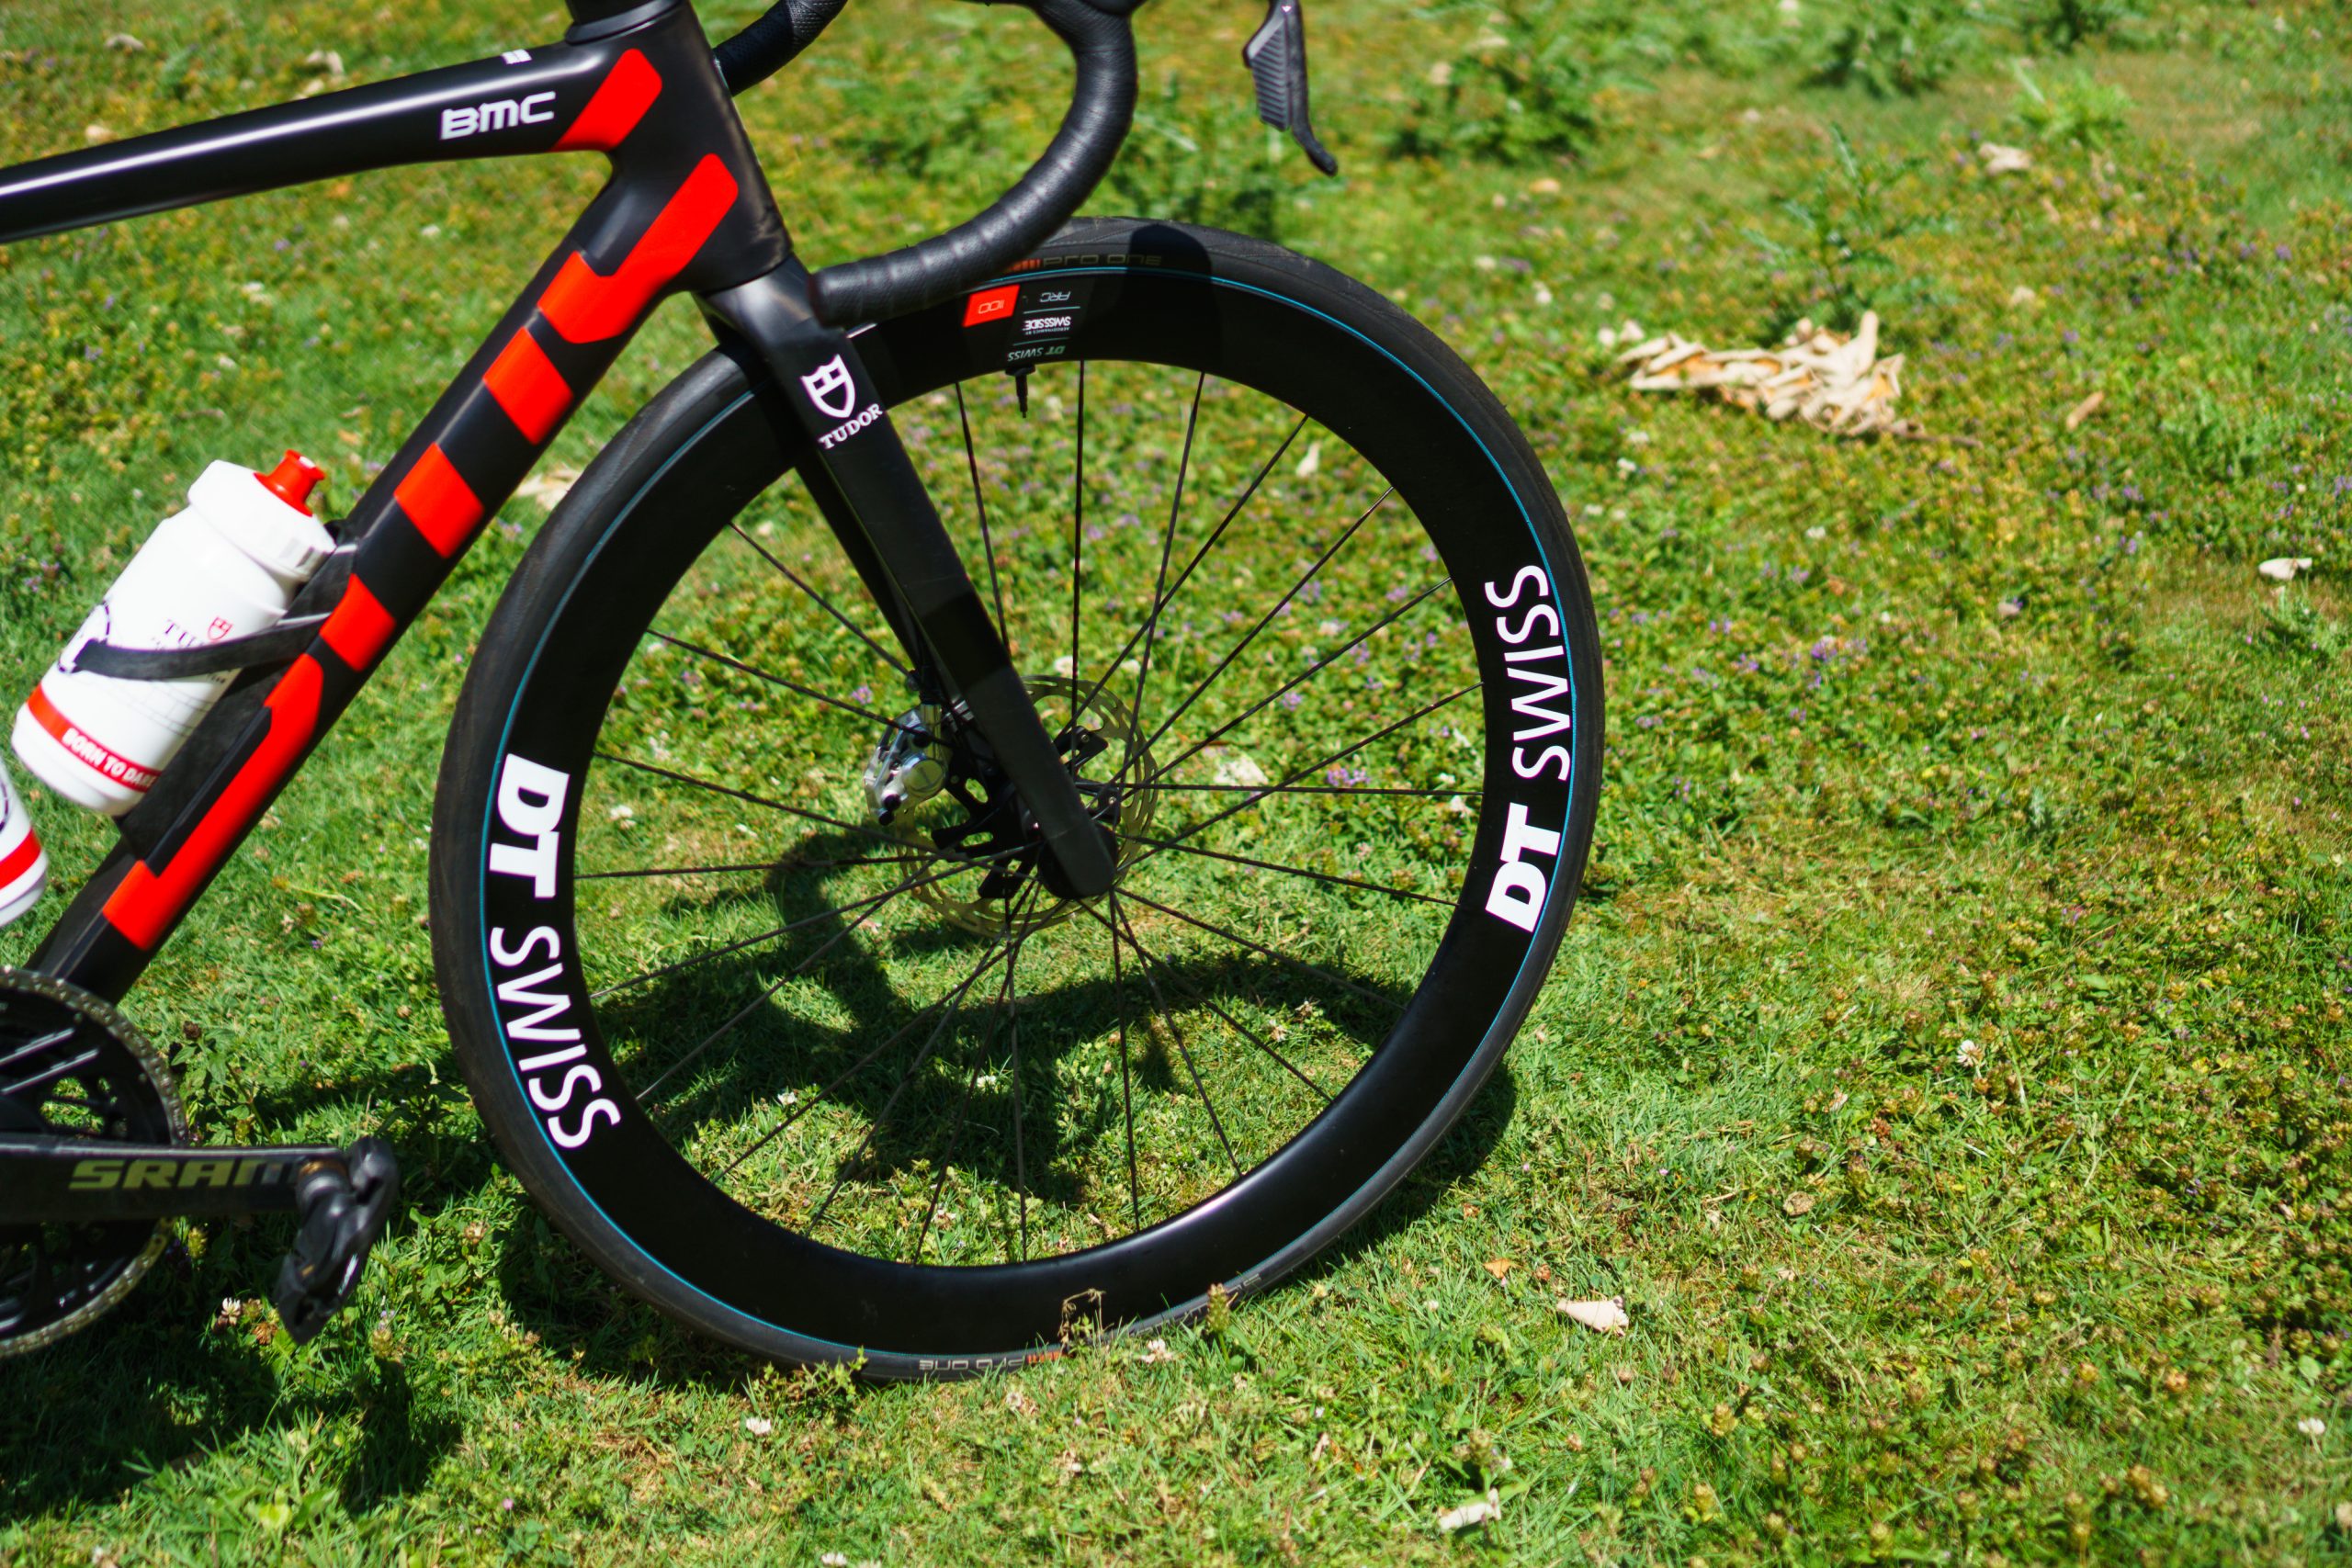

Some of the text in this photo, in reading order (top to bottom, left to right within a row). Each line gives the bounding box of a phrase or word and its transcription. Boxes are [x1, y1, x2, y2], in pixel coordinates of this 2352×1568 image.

[440, 91, 556, 141] BMC
[1039, 290, 1071, 303] ARC
[1007, 345, 1066, 362] DT SWISS
[819, 403, 883, 449] TUDOR
[62, 727, 108, 768] BORN
[103, 755, 128, 777] TO
[1484, 565, 1570, 933] DT SWISS
[489, 753, 621, 1148] DT SWISS
[68, 1159, 299, 1190] SRAM
